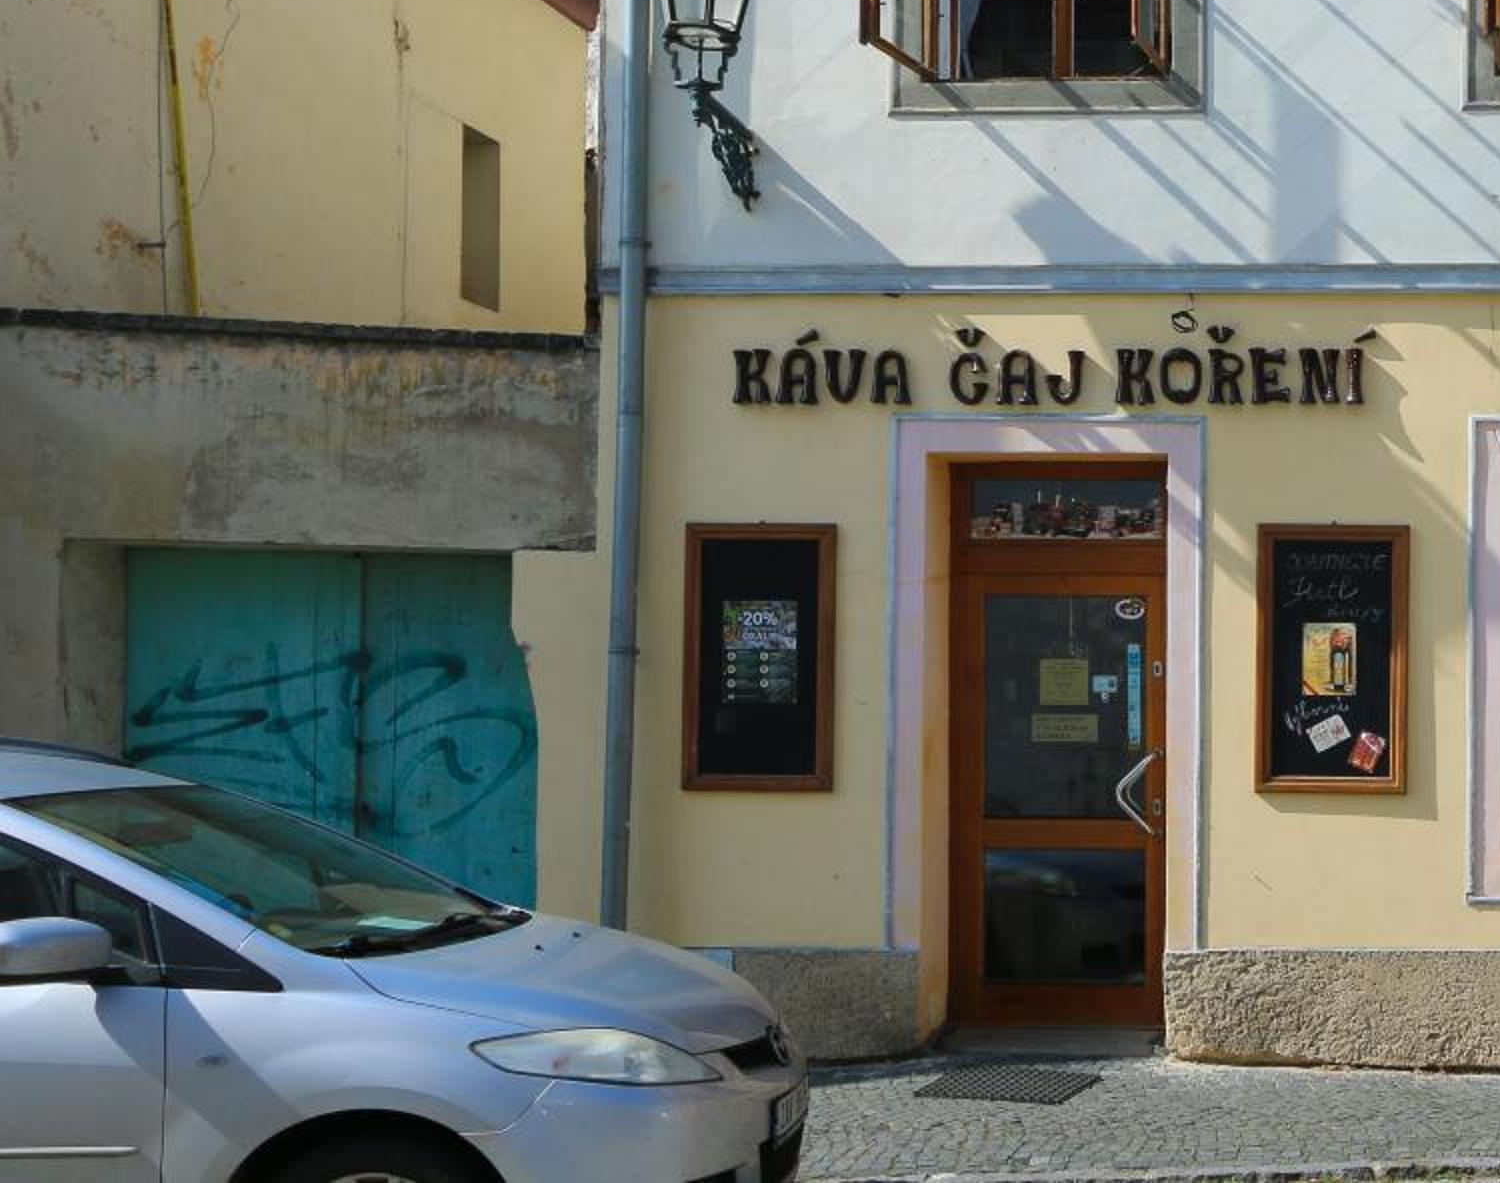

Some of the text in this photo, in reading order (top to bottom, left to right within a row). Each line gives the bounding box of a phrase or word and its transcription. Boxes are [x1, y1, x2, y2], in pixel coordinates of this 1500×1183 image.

[732, 325, 1378, 407] KÁVA ČAJ KOŘENÍ
